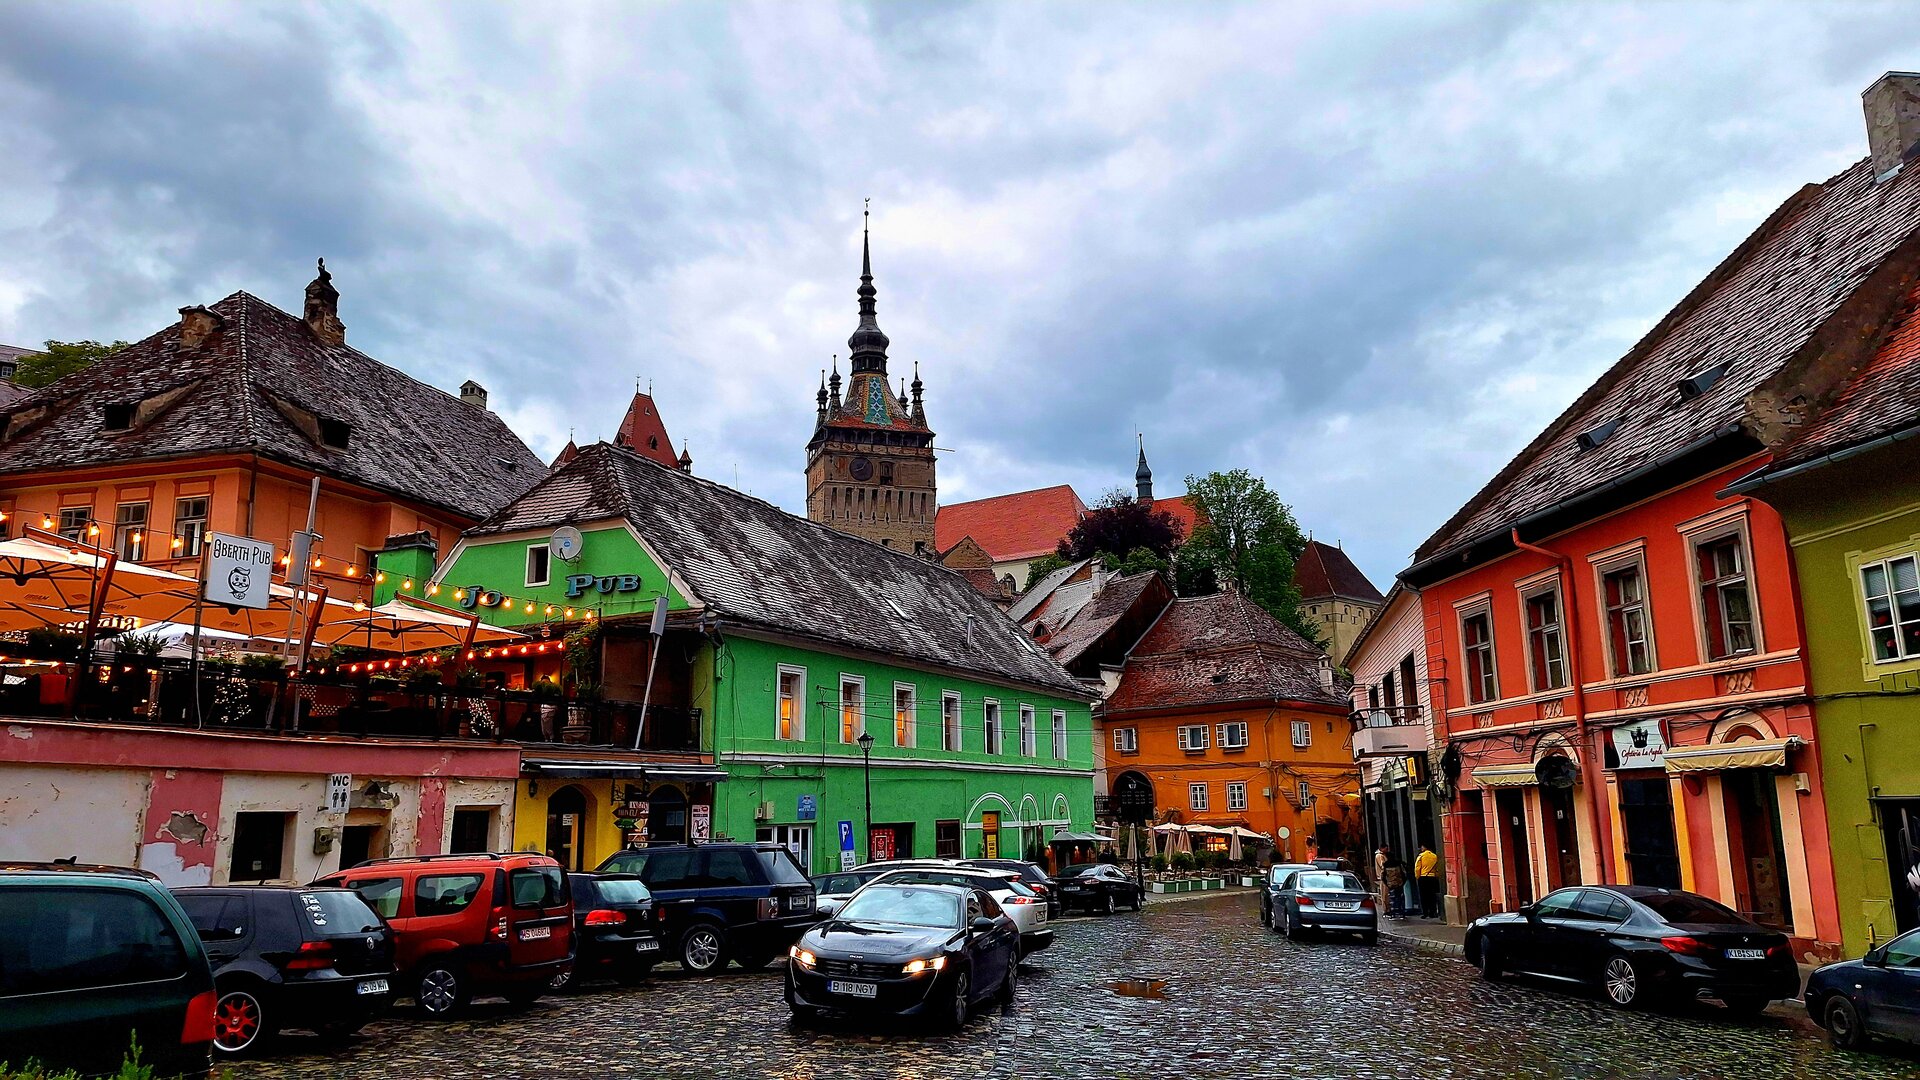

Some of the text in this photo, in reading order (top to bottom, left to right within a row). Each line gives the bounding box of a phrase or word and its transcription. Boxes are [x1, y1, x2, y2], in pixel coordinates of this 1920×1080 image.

[331, 775, 350, 787] WC
[841, 823, 850, 843] P
[833, 981, 876, 995] B 118 NGY
